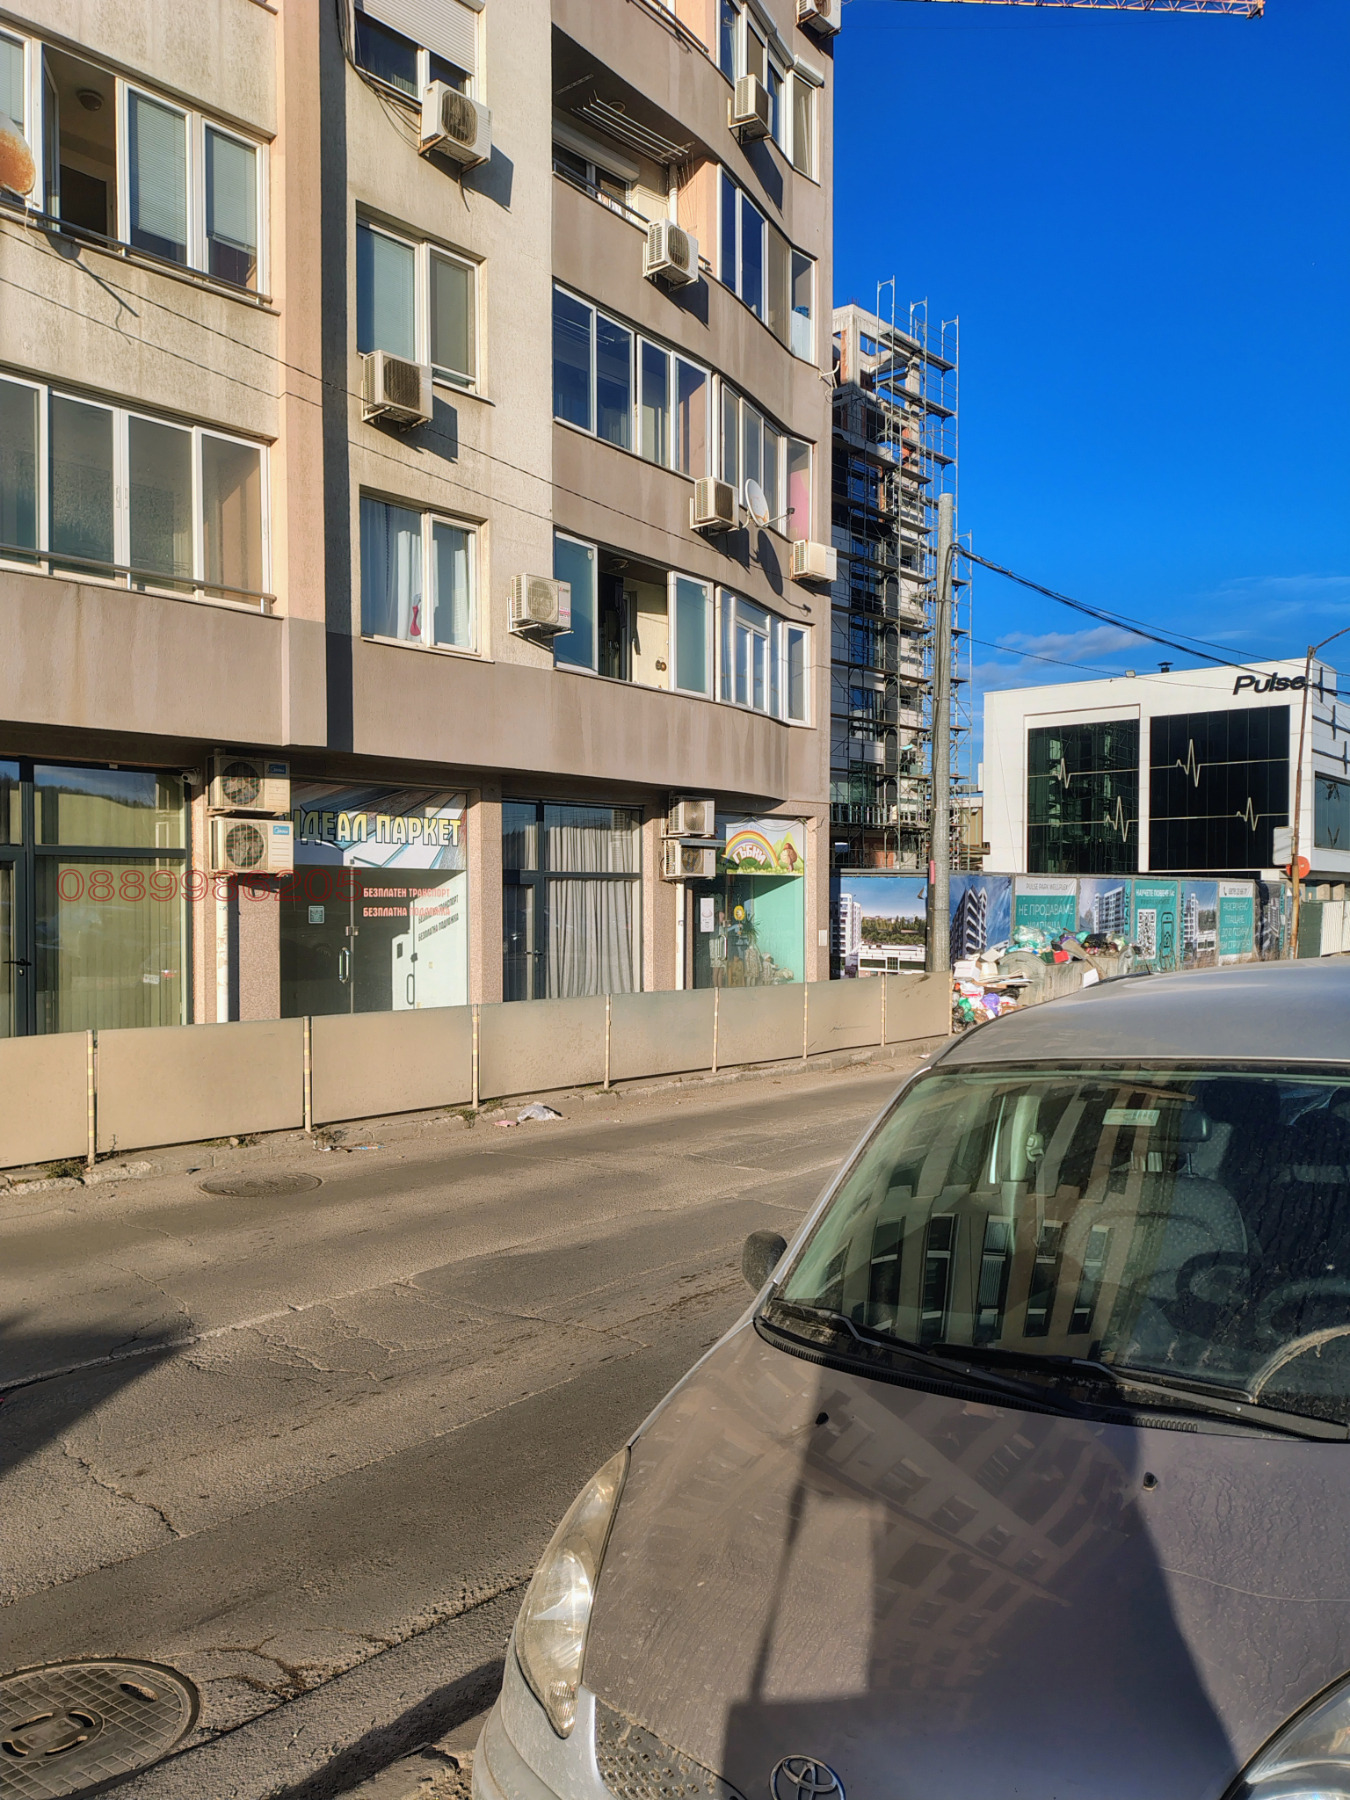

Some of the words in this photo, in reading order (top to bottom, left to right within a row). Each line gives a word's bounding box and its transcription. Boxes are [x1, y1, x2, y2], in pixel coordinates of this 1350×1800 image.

[1232, 672, 1306, 695] Pulse
[376, 814, 462, 848] ПАРКЕТ
[363, 887, 407, 898] БЕЗПЛАТЕН
[409, 887, 450, 898] ТРАНСПОРТ
[363, 906, 407, 917] БЕЗПЛАТНА
[1018, 904, 1028, 916] НЕ
[1030, 904, 1074, 917] ПРОДАВАМЕ
